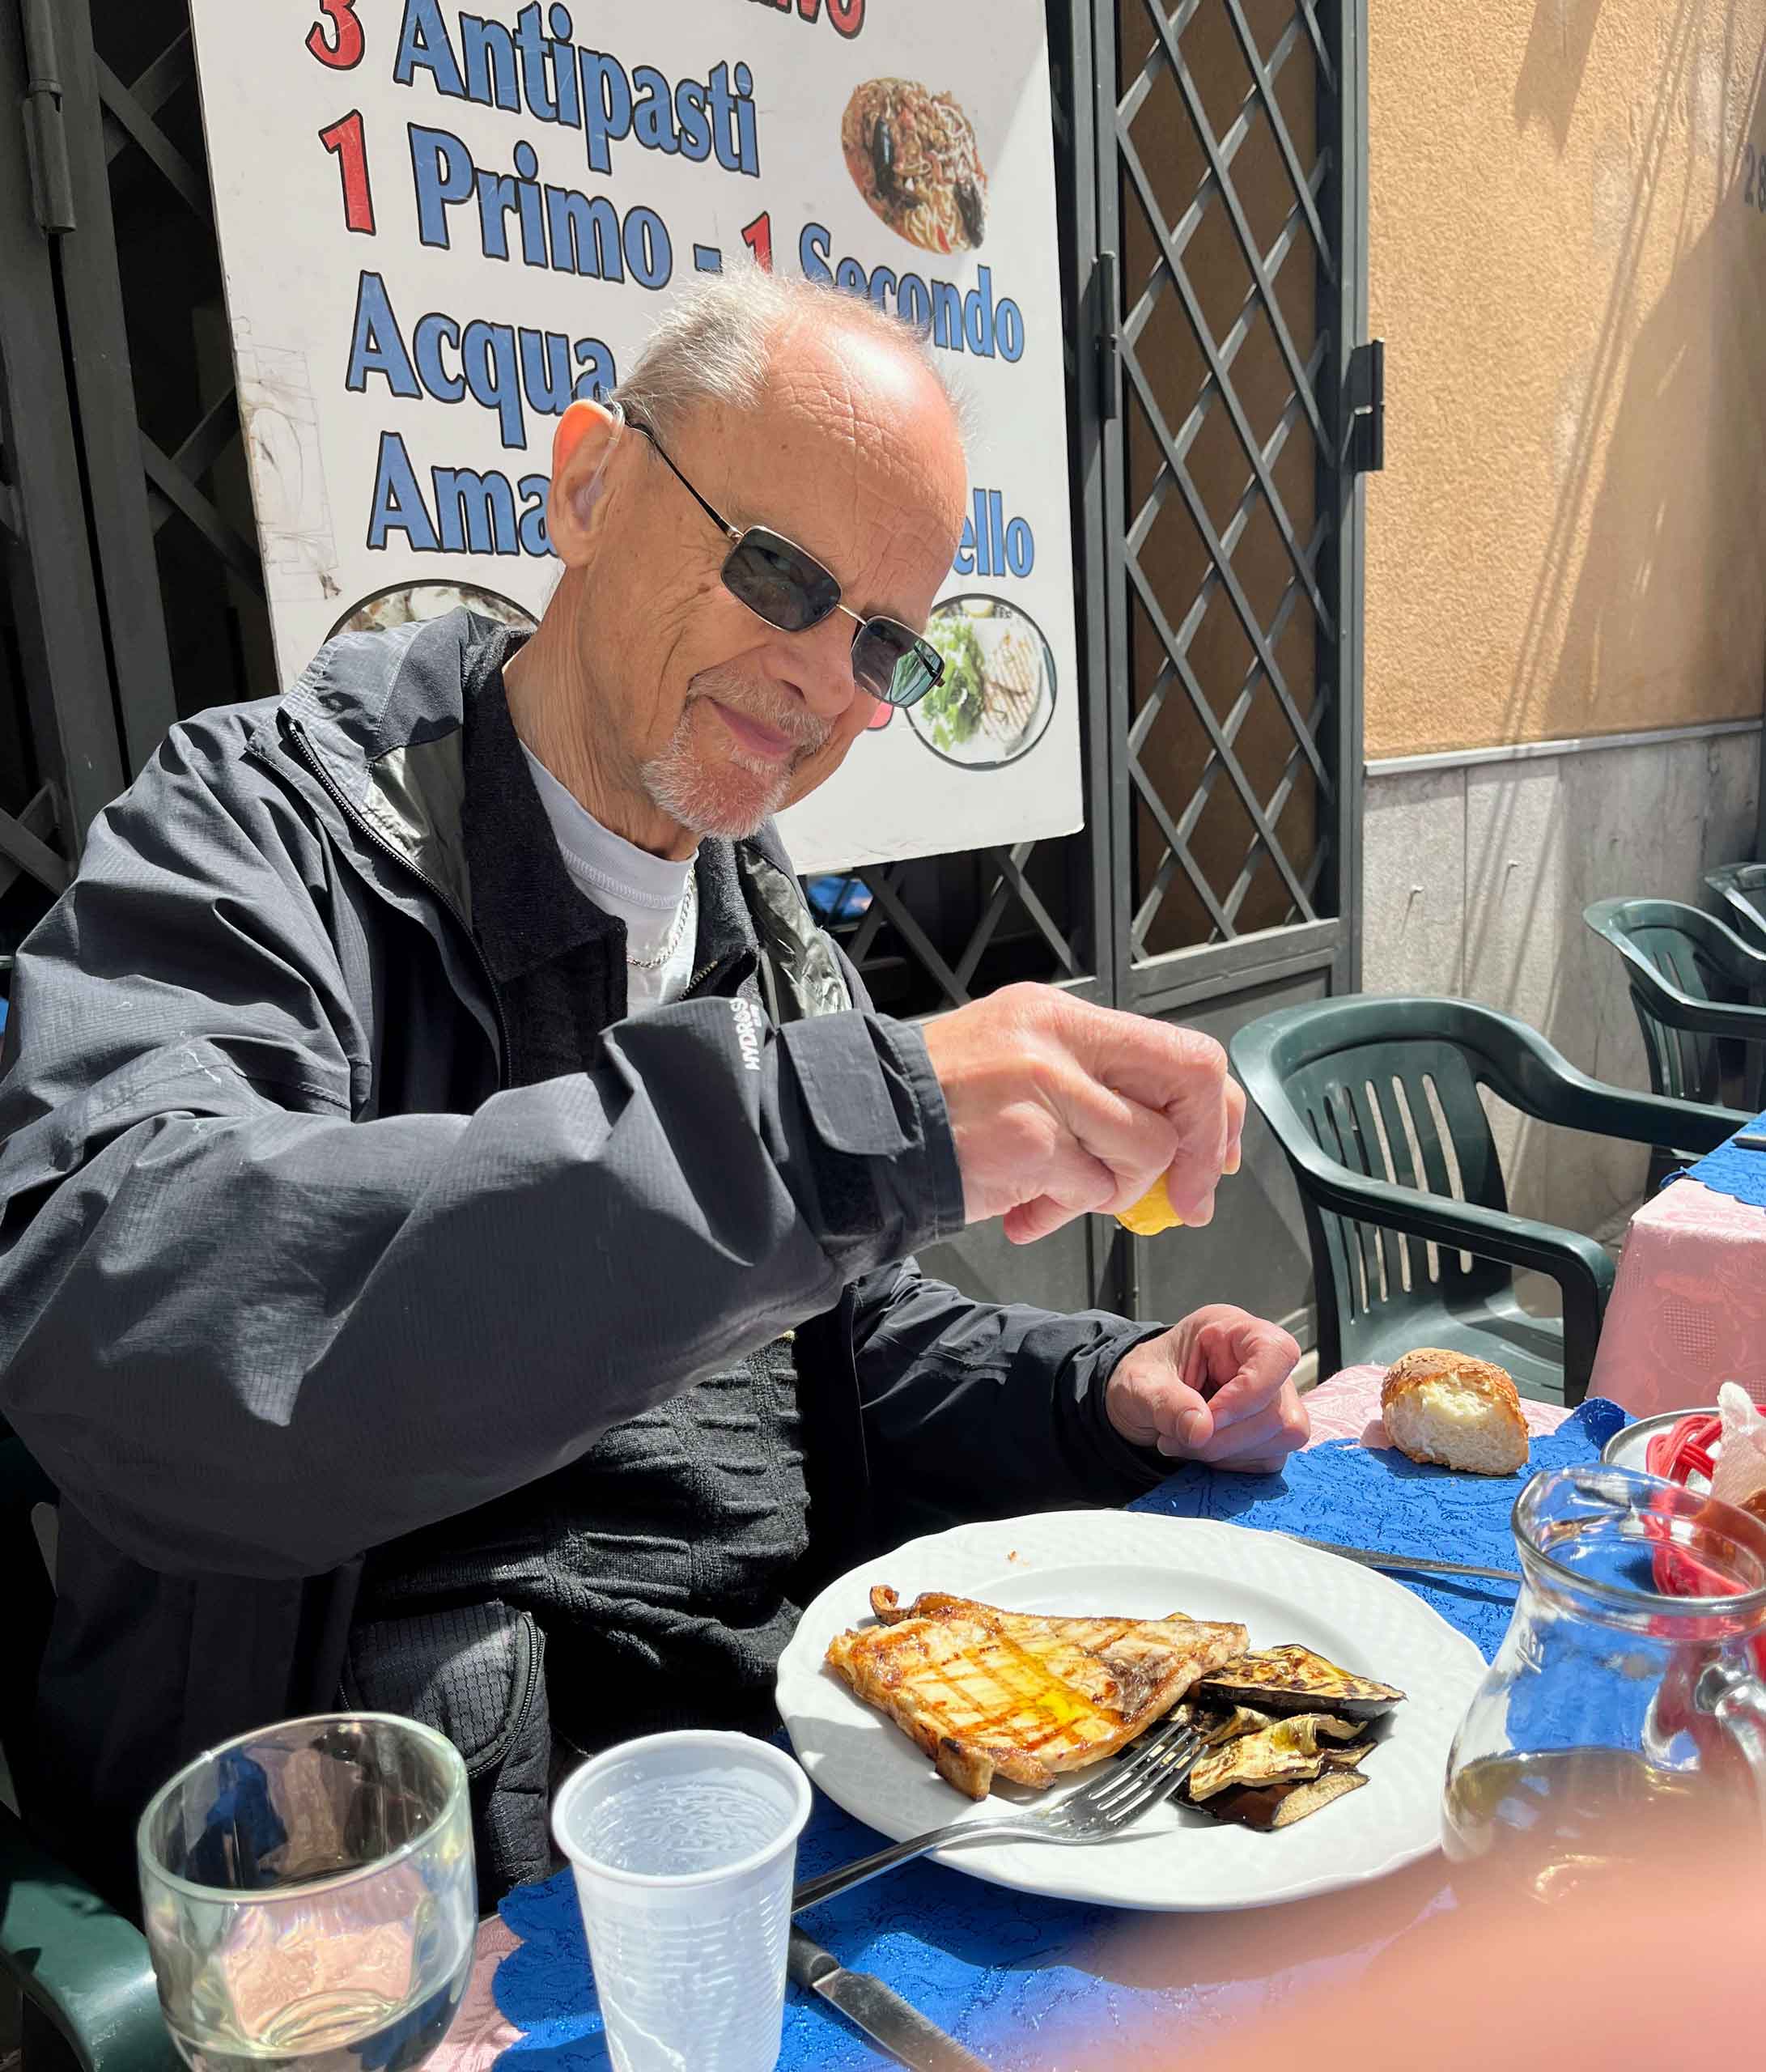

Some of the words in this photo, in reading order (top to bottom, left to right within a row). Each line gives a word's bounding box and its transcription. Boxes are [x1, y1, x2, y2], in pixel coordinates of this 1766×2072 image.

[306, 0, 364, 70] 3
[393, 0, 760, 177] Antipasti
[319, 108, 376, 236] 1
[407, 122, 673, 291] Primo
[346, 270, 618, 450] Acqua
[367, 431, 558, 558] Ama
[952, 487, 1035, 579] ello
